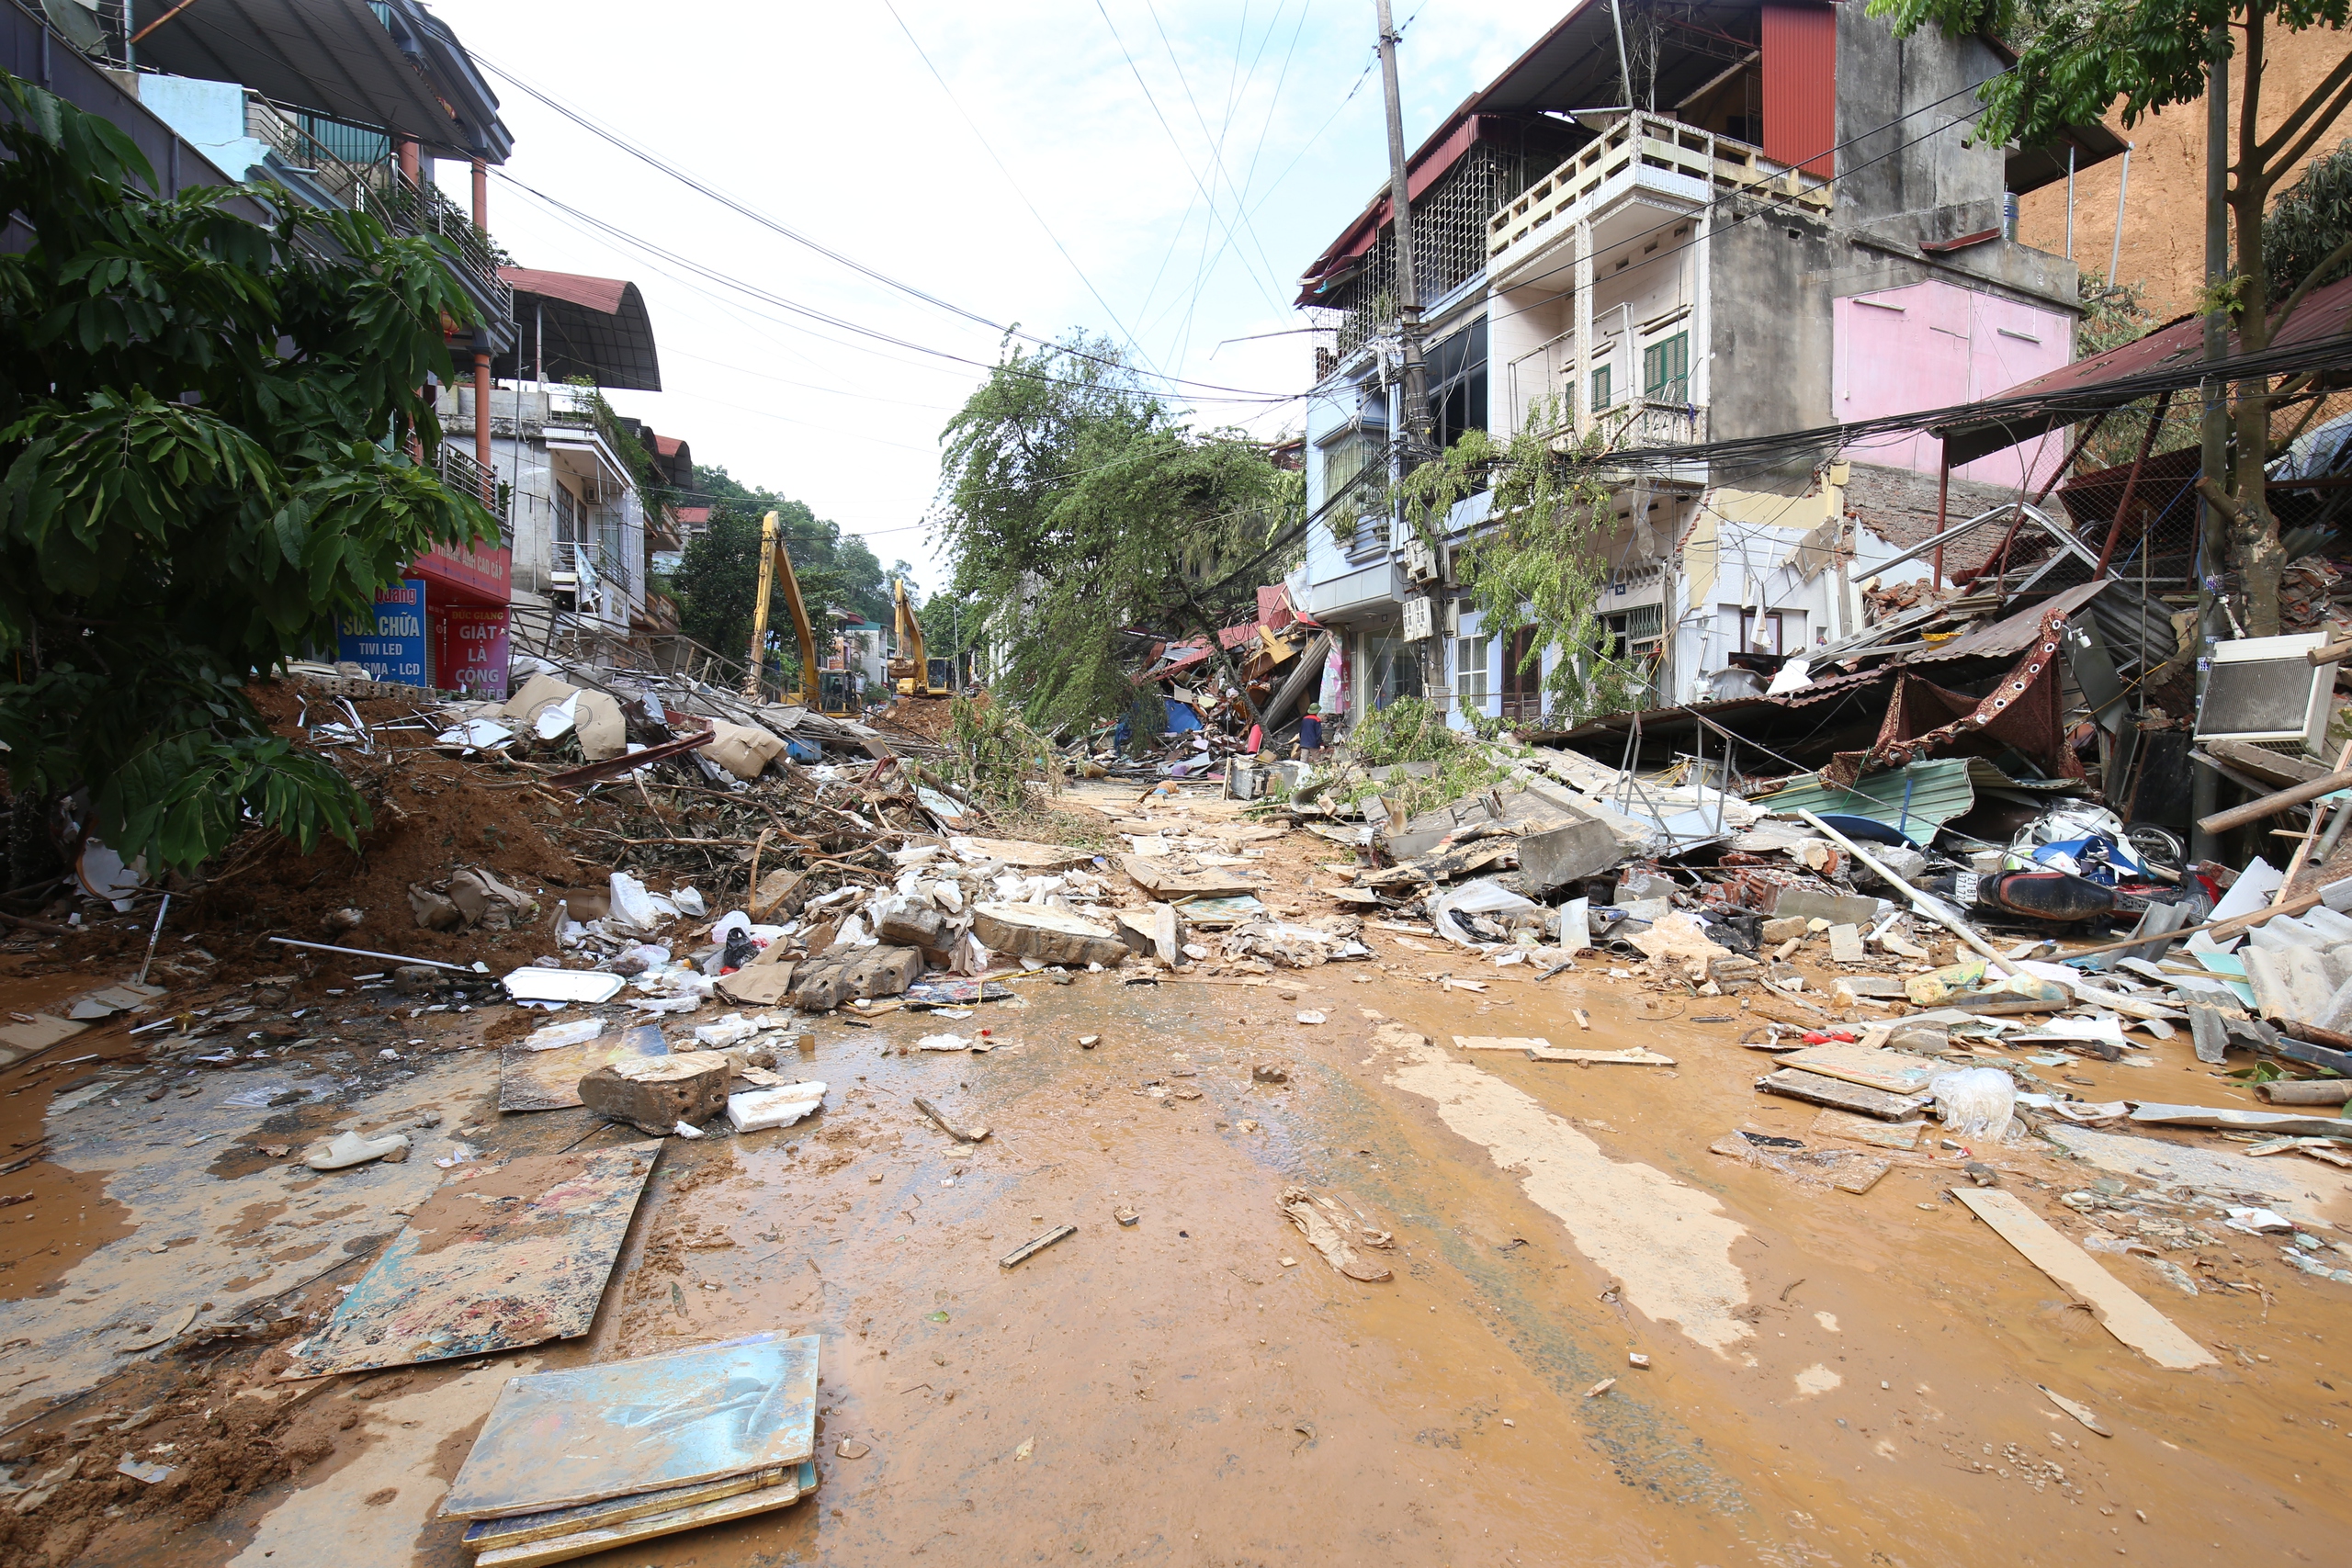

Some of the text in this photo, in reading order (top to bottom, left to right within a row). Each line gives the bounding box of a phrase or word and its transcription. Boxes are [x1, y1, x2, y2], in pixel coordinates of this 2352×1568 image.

[477, 556, 490, 575] CAO
[375, 585, 417, 605] Quang
[452, 610, 504, 620] ĐỨC GIANG
[379, 612, 420, 637] CHỮA
[459, 622, 497, 644] GIẶT
[358, 643, 402, 655] TIVI LED
[468, 645, 488, 662] LÀ
[399, 663, 420, 675] LCD
[455, 666, 499, 683] CÔNG
[1956, 874, 1967, 900] 371.72
